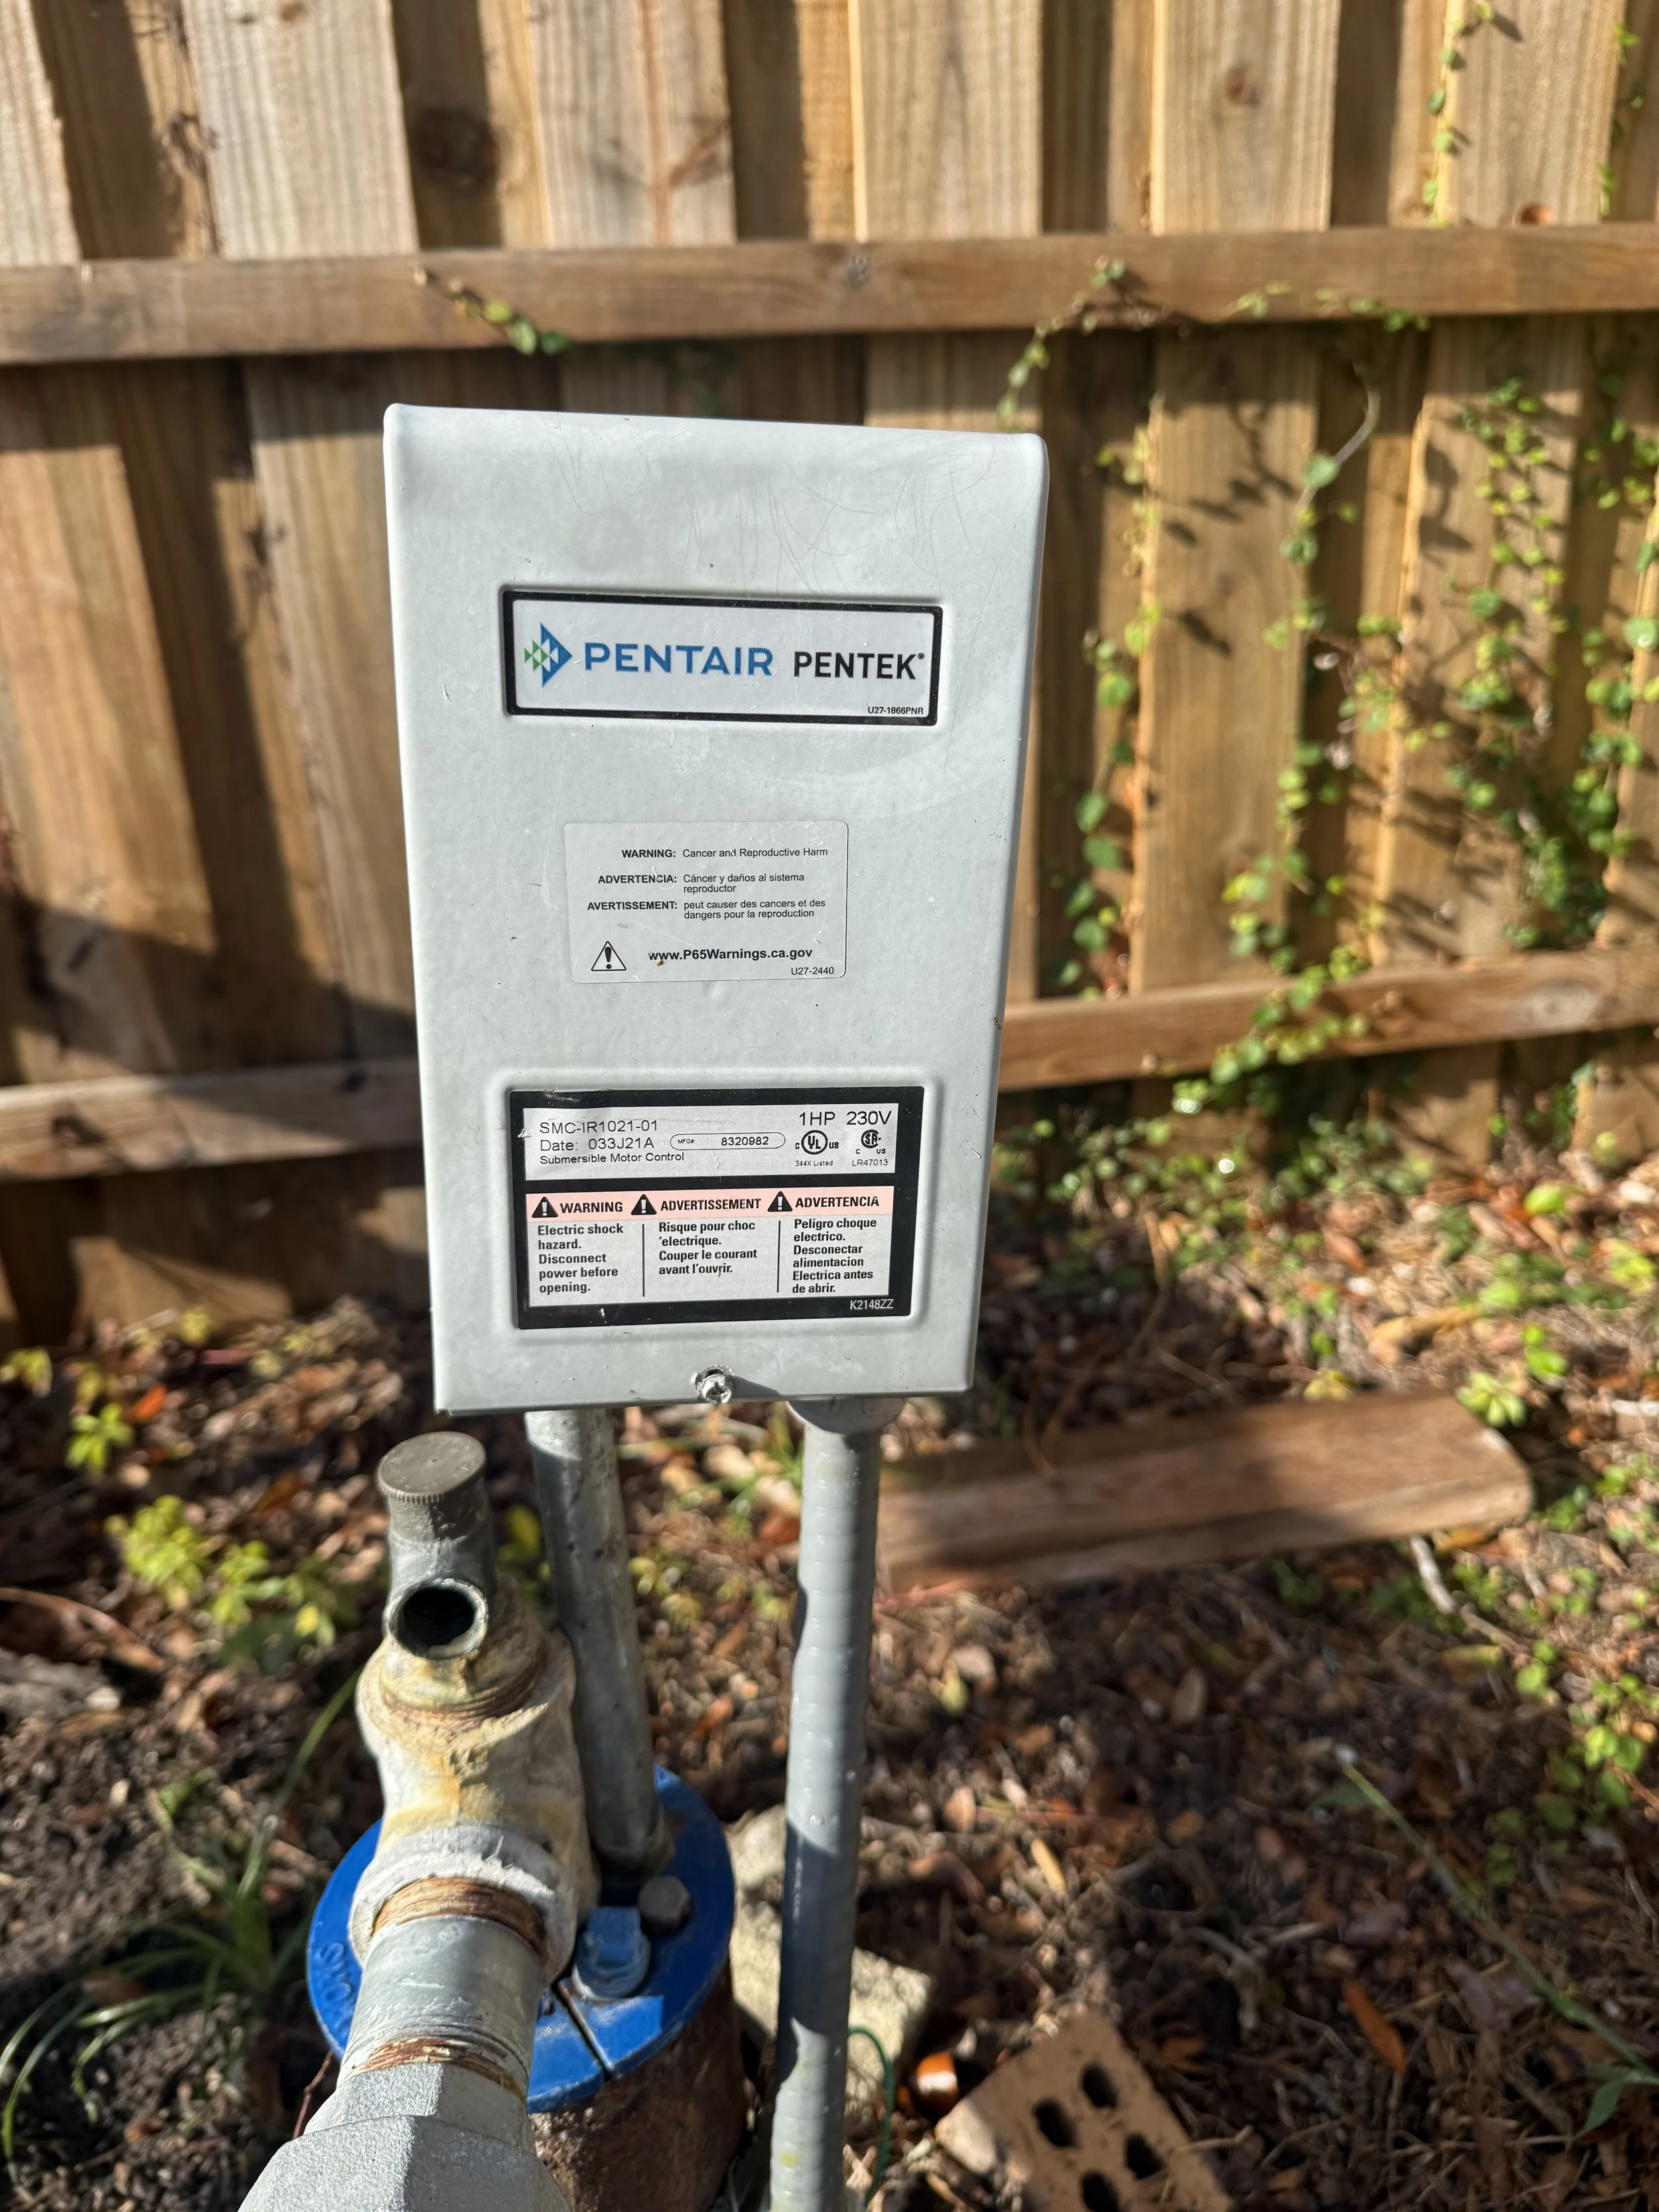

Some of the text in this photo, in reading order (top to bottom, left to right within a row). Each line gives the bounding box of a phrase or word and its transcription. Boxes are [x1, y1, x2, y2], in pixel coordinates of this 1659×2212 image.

[585, 642, 773, 676] PENTAIR
[868, 706, 924, 715] U27-1866PNR
[622, 848, 828, 858] WARNING: Cancer and Reproductive Harm
[598, 875, 677, 883] ADVERTENCIA:
[684, 874, 717, 883] Cáncer
[727, 873, 755, 882] daños
[684, 884, 736, 894] reproductor
[587, 901, 678, 911] AVERTISSEMENT:
[684, 901, 704, 911] peut
[741, 900, 757, 909] des
[684, 910, 721, 921] dangers
[758, 909, 814, 918] reproduction
[648, 948, 813, 962] www.P65Warnings.ca.gov
[791, 966, 834, 976] U27-2440
[800, 1111, 892, 1126] 1HP 230V
[540, 1120, 657, 1134] SMC-IR1021-01
[540, 1138, 654, 1151] Date: 033J21A
[721, 1136, 769, 1146] 8320982
[540, 1152, 684, 1164] Submersible Motor Control
[560, 1202, 623, 1214] WARNING
[661, 1199, 762, 1211] ADVERTISSEMENT
[795, 1197, 879, 1208] ADVERTENCIA
[538, 1224, 624, 1236] Electric shock
[659, 1220, 755, 1234] Risque pour choc
[794, 1218, 877, 1231] Peligro choque
[794, 1231, 845, 1242] electrico.
[538, 1238, 581, 1250] hazard.
[793, 1244, 863, 1255] Desconectar
[539, 1253, 607, 1264] Disconnect
[659, 1249, 757, 1263] Couper le courant
[792, 1256, 864, 1268] alimentacion
[539, 1266, 618, 1280] power before
[659, 1265, 689, 1275] avant
[792, 1270, 873, 1281] Electrica antes
[540, 1282, 591, 1295] opening.
[792, 1282, 835, 1293] de abrir.
[850, 1298, 894, 1310] K2148ZZ
